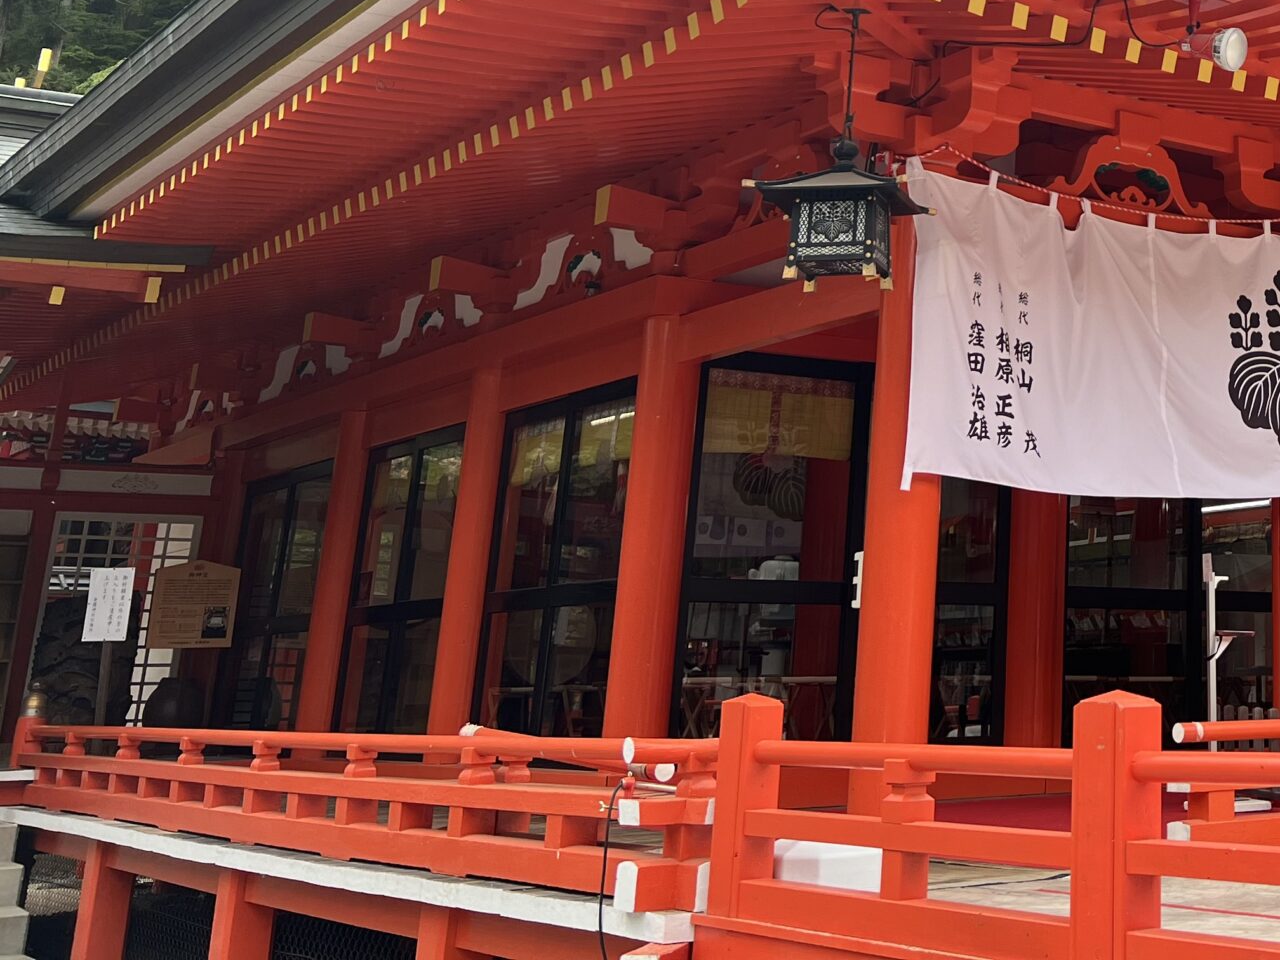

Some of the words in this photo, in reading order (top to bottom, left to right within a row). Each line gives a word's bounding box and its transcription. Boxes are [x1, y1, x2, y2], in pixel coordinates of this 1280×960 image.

[967, 320, 990, 441] 窪田治雄
[1014, 338, 1033, 394] 桐山
